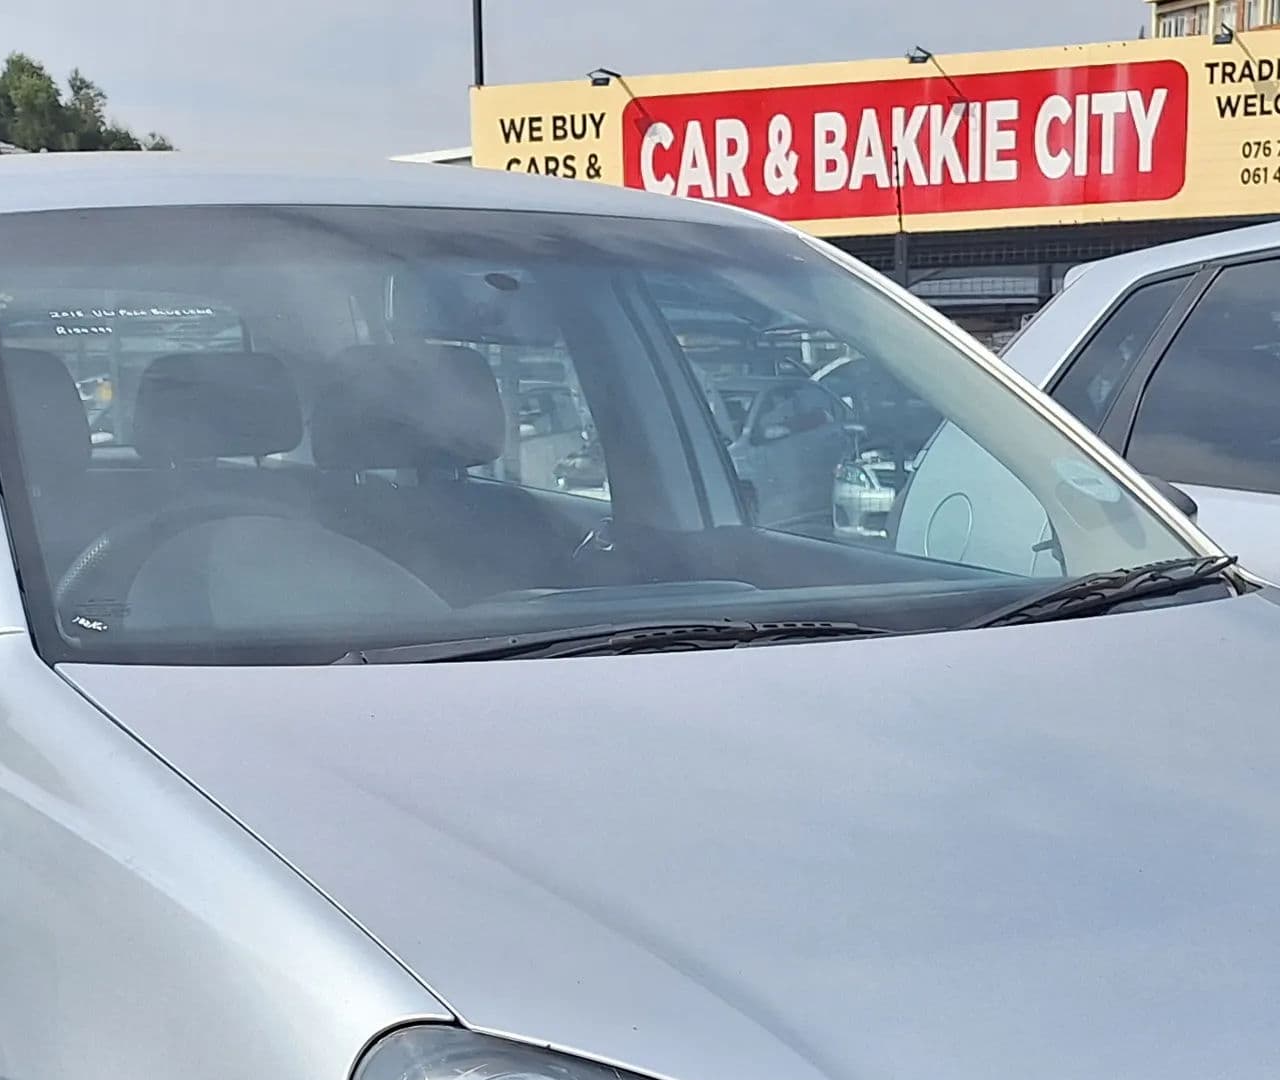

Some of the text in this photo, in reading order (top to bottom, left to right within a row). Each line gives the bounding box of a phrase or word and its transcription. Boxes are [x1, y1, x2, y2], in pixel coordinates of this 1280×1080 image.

[500, 112, 606, 143] WE BUY
[640, 87, 1168, 199] CAR & BAKKIE CITY
[1242, 140, 1271, 158] 076
[586, 153, 602, 179] &
[1240, 167, 1268, 185] 061
